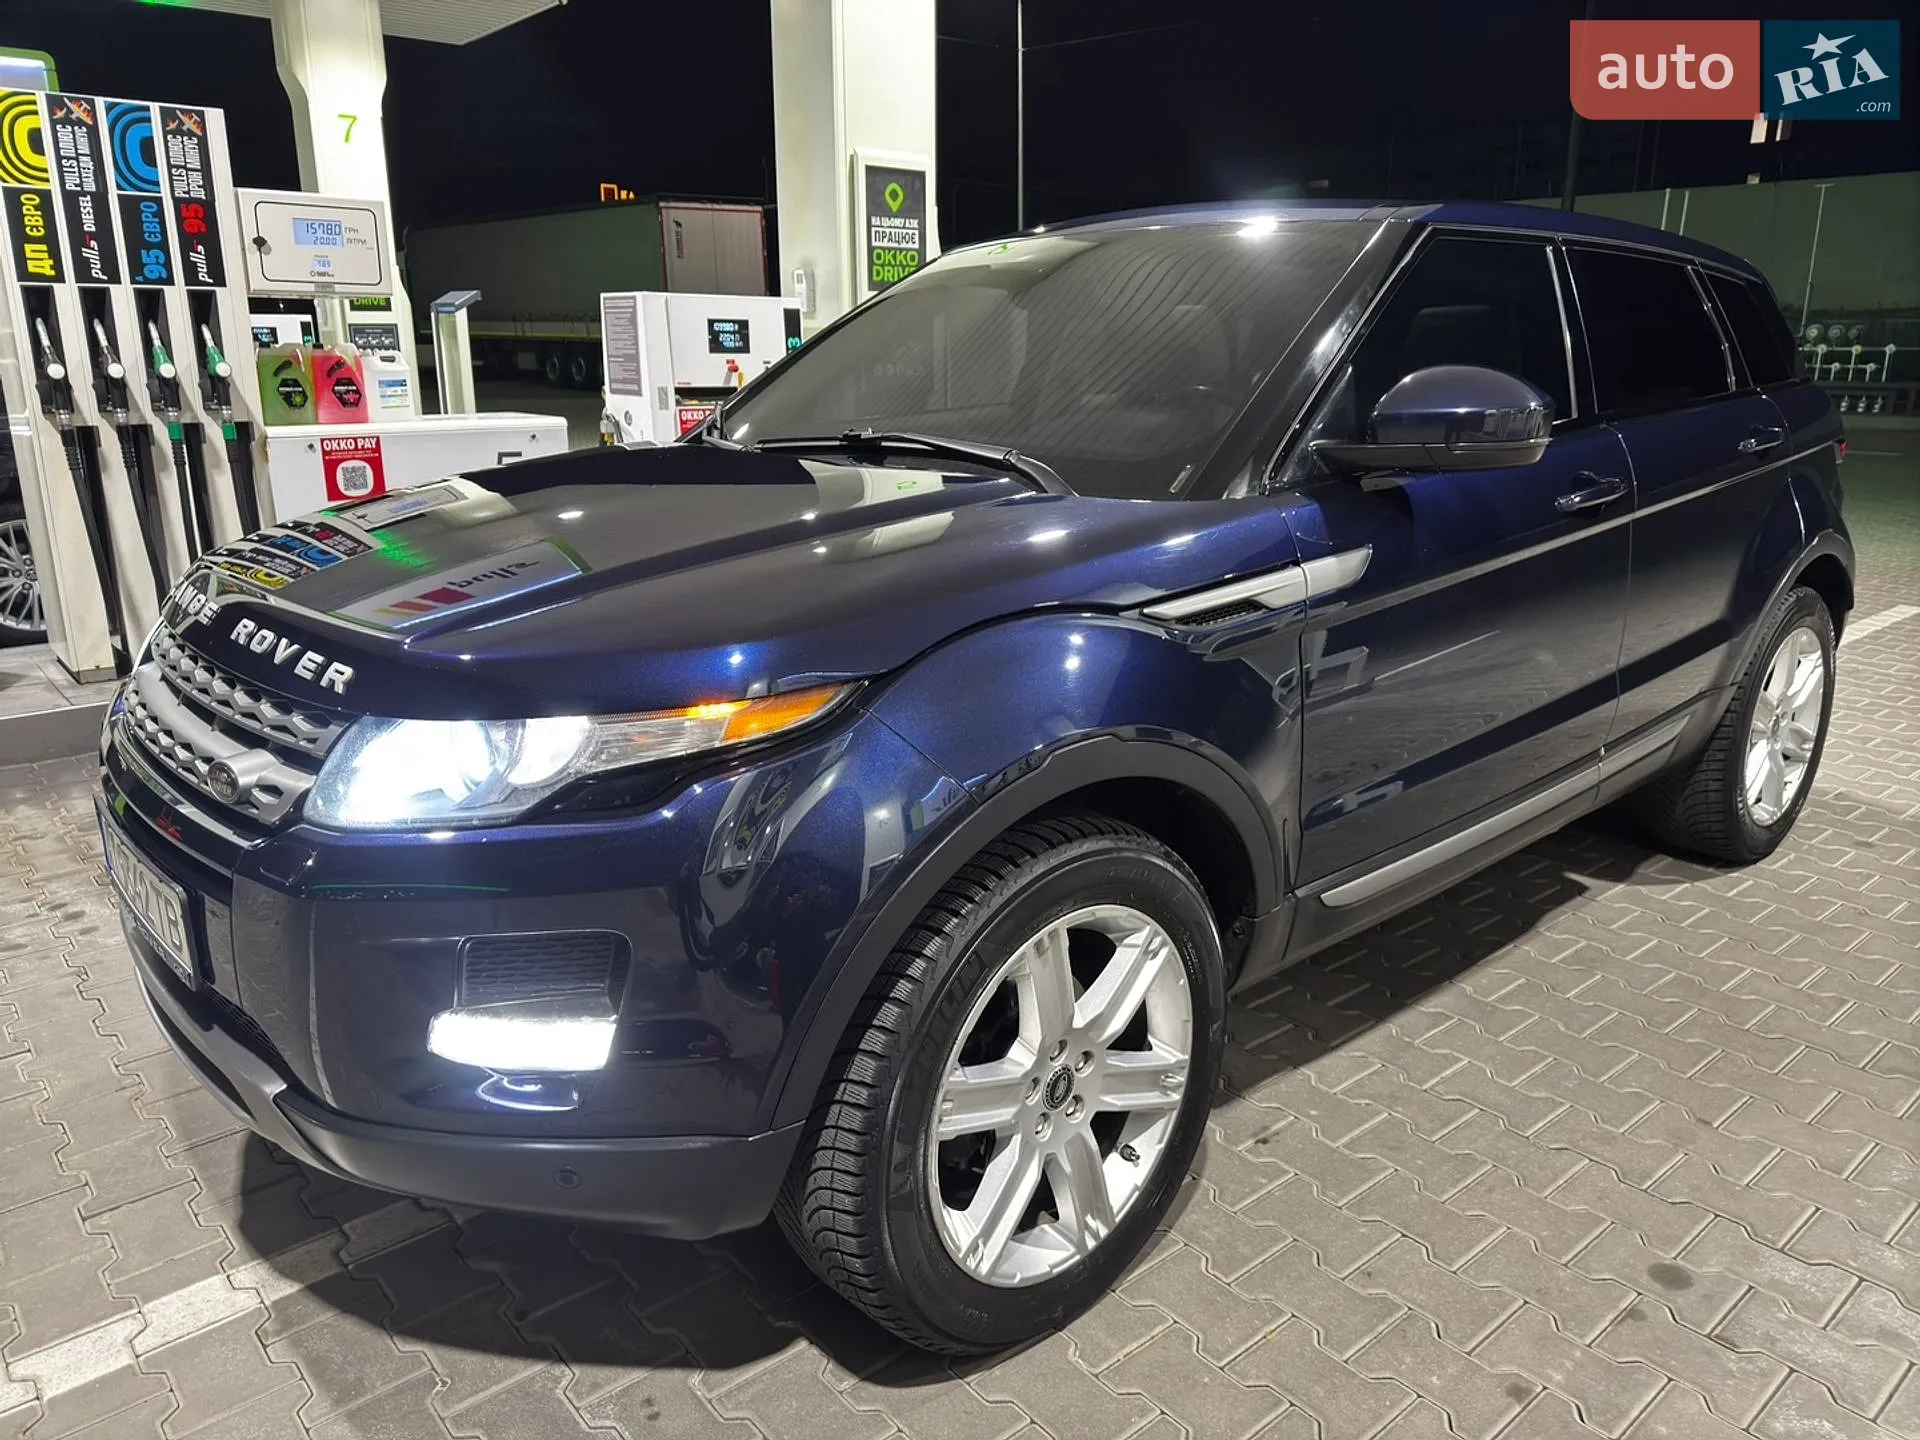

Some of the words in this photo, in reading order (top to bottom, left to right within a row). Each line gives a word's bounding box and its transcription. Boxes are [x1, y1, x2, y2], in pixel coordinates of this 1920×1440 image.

[337, 113, 358, 144] 7
[60, 158, 81, 191] PULLS
[169, 167, 190, 199] PULLS
[20, 193, 46, 237] ЄВРО
[79, 194, 96, 232] DIESEL
[140, 201, 162, 242] ЄВРО
[181, 202, 208, 235] 95
[874, 230, 917, 245] ПРАЦЮЄ
[24, 243, 55, 277] ДП
[81, 234, 108, 281] pulls
[142, 249, 168, 281] 95
[190, 239, 214, 283] pulls
[873, 248, 919, 266] OKKO
[681, 410, 704, 421] OKKO
[323, 438, 355, 451] OKKO
[357, 436, 378, 449] PAY
[229, 617, 355, 695] ROVER
